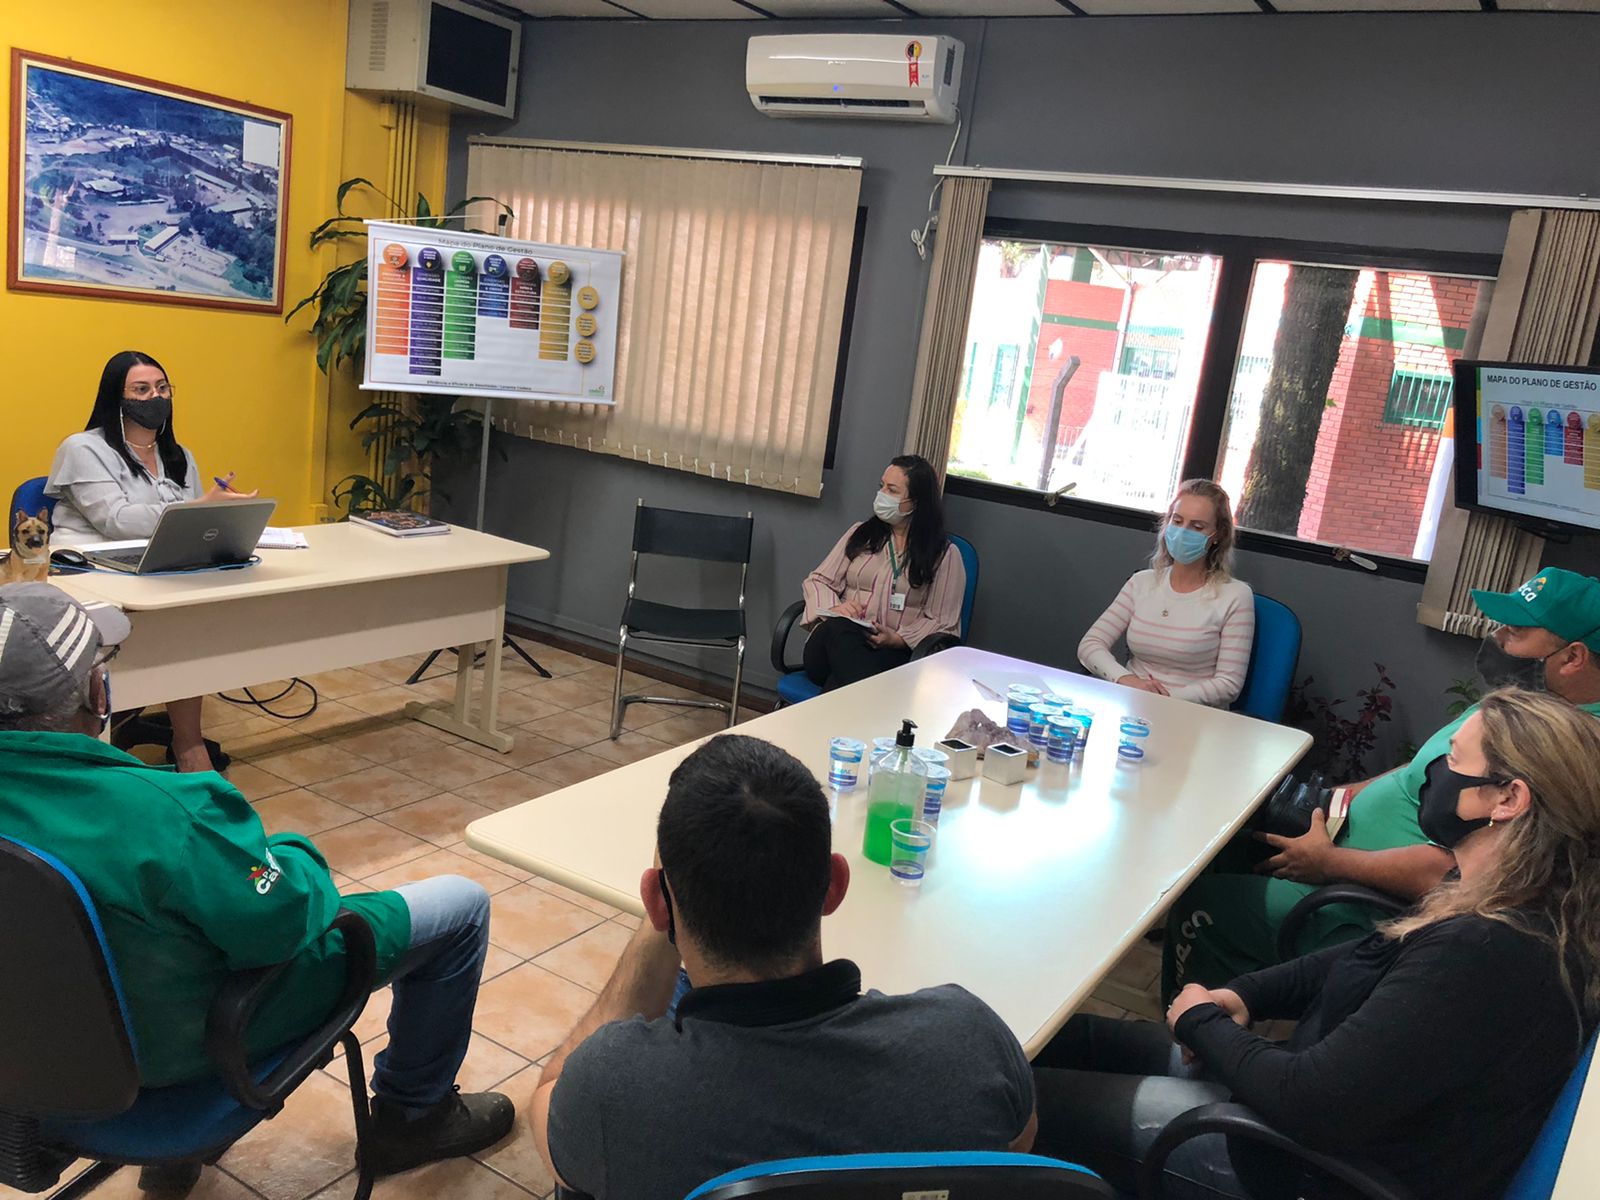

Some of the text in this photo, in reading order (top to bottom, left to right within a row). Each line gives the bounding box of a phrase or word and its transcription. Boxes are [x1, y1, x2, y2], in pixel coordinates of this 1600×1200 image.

[1487, 375, 1597, 391] MAPA DO PLANO DE GESTÃO
